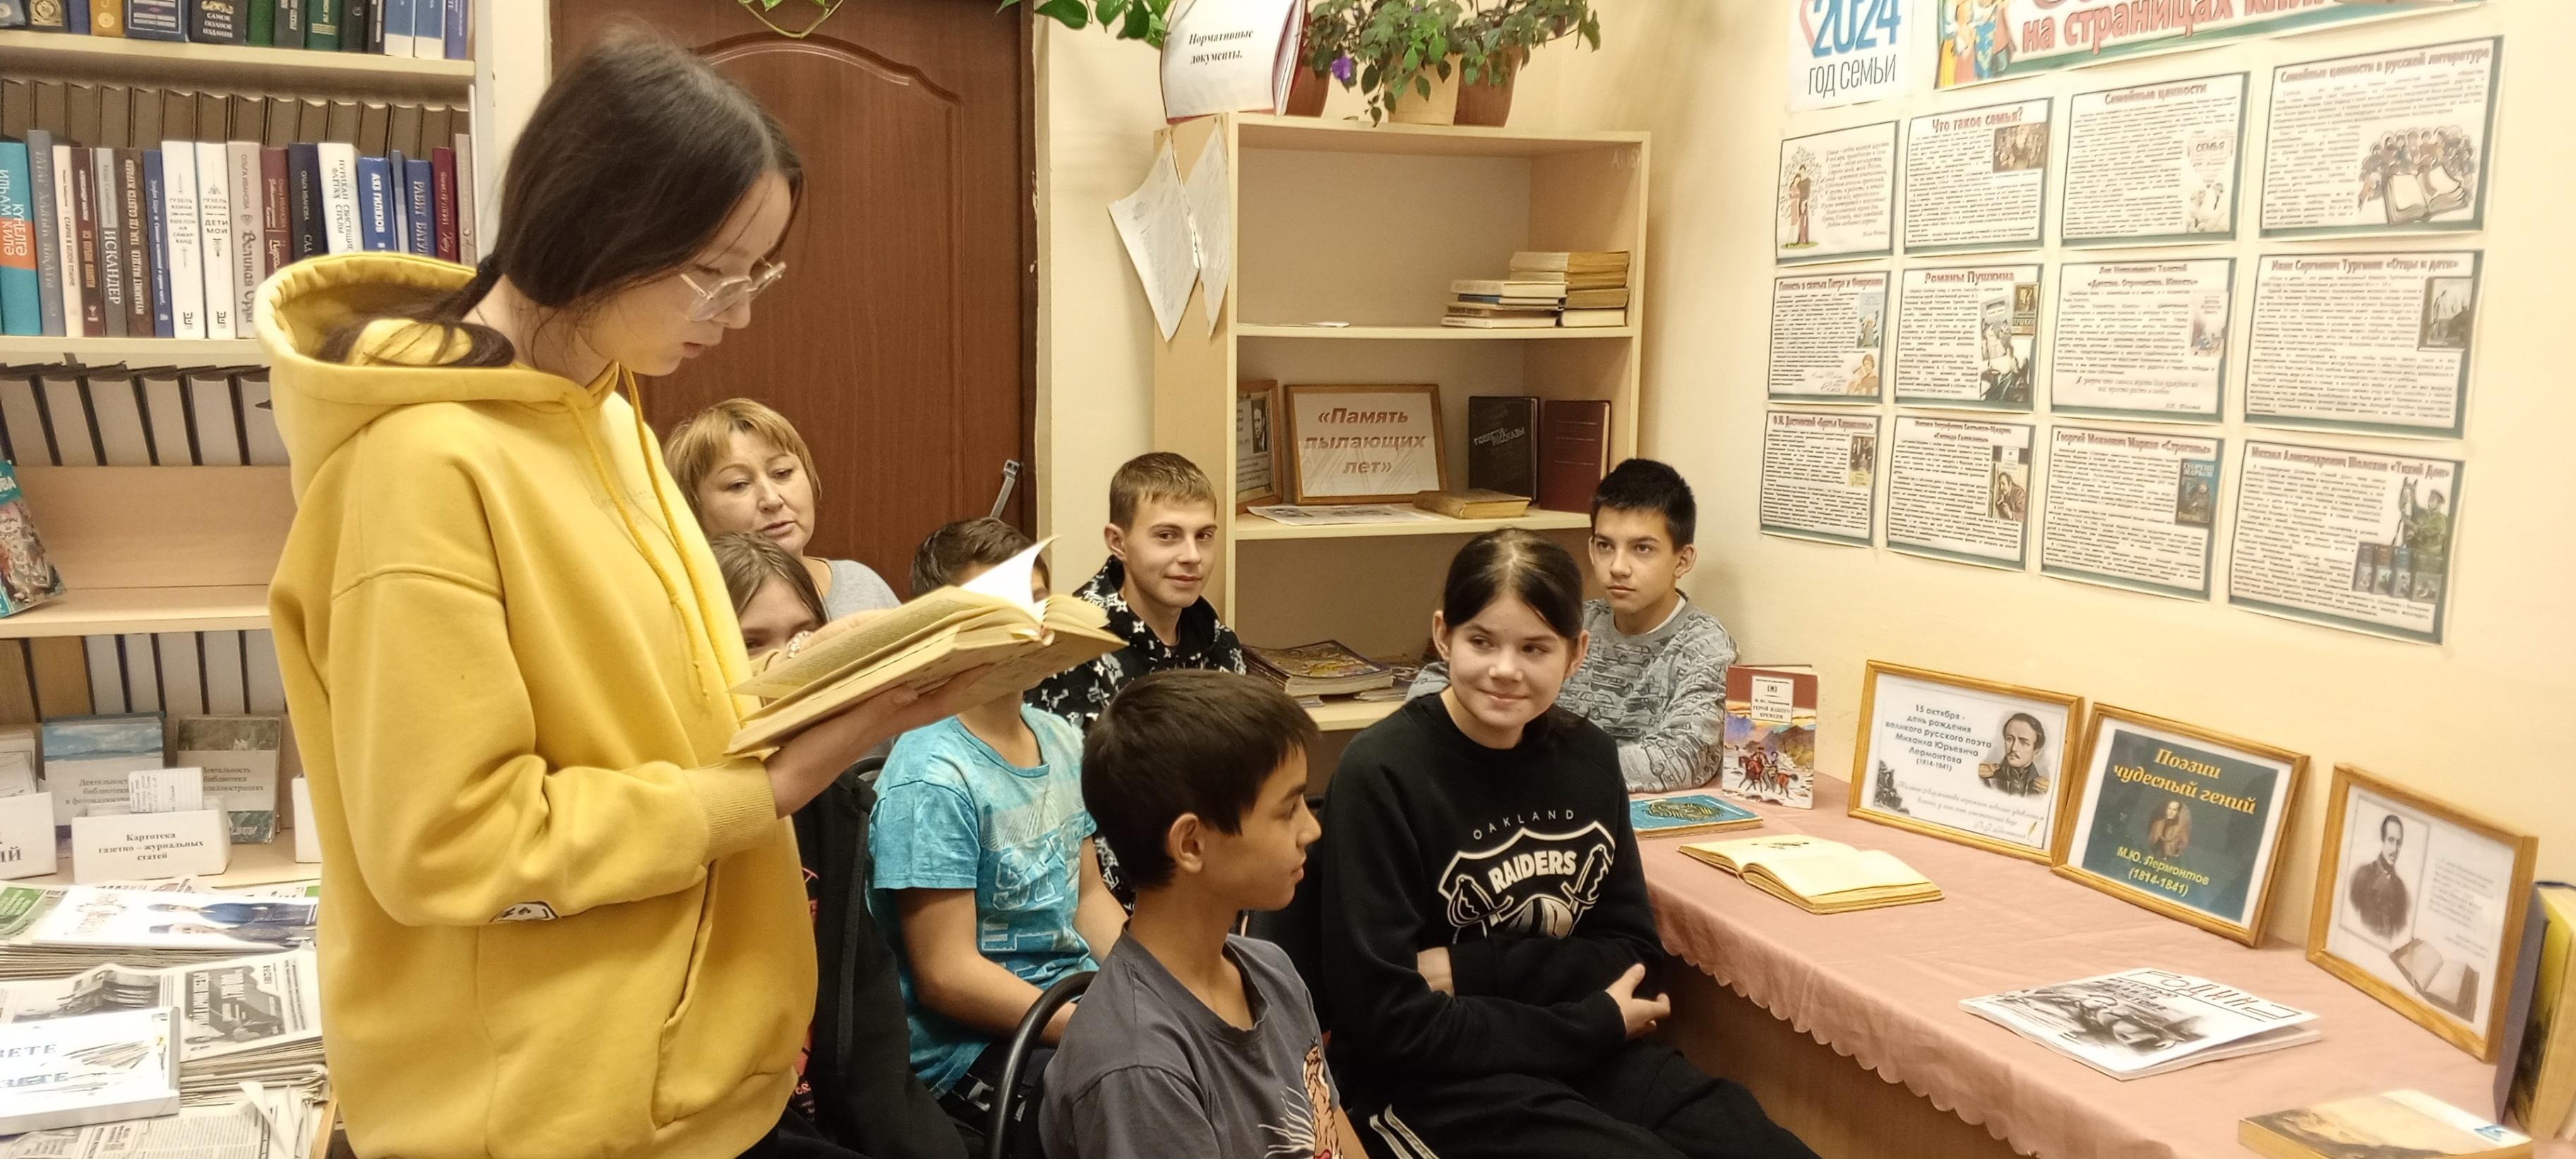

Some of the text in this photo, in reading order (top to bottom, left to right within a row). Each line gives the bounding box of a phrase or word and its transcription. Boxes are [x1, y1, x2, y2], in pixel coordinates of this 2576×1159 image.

[1189, 28, 1254, 47] Нормативные
[1813, 0, 1902, 58] 2024
[2022, 0, 2234, 55] на страницах
[1190, 49, 1243, 66] документы.
[2330, 62, 2373, 78] ценности
[2385, 53, 2425, 73] русской
[2158, 83, 2207, 101] ценности
[1932, 107, 2023, 133] Что такое семья?
[371, 172, 386, 233] АЯЗ ГИЛЯЗОВ
[413, 180, 427, 216] РАБИТ
[204, 219, 229, 227] ДЕТИ
[104, 230, 121, 304] ИСКАНДЕР
[1925, 271, 2015, 285] Романы Пушкина
[1318, 407, 1409, 427] «Память
[1304, 434, 1426, 451] пылающих
[1342, 459, 1392, 475] лет»
[1915, 704, 1925, 713] 15
[1926, 707, 1960, 720] октября
[1885, 721, 1992, 749] великого русского поэта
[1907, 715, 1972, 733] день рождения
[1895, 732, 1979, 757] Михаила Юрьевича
[1909, 747, 1962, 765] Лермонтова
[1916, 758, 1952, 773] (1814-1841)
[2154, 748, 2222, 779] Поэзии
[2113, 764, 2257, 814] чудесный гений
[1473, 809, 1575, 840] OAKLAND
[99, 843, 134, 854] газетно
[144, 840, 204, 852] журнальных
[126, 832, 177, 843] Картотека
[137, 852, 168, 862] статей
[2117, 846, 2210, 886] М.Ю. Лермонтов
[1488, 850, 1578, 895] RAIDERS
[2128, 867, 2190, 897] (1814-1841)
